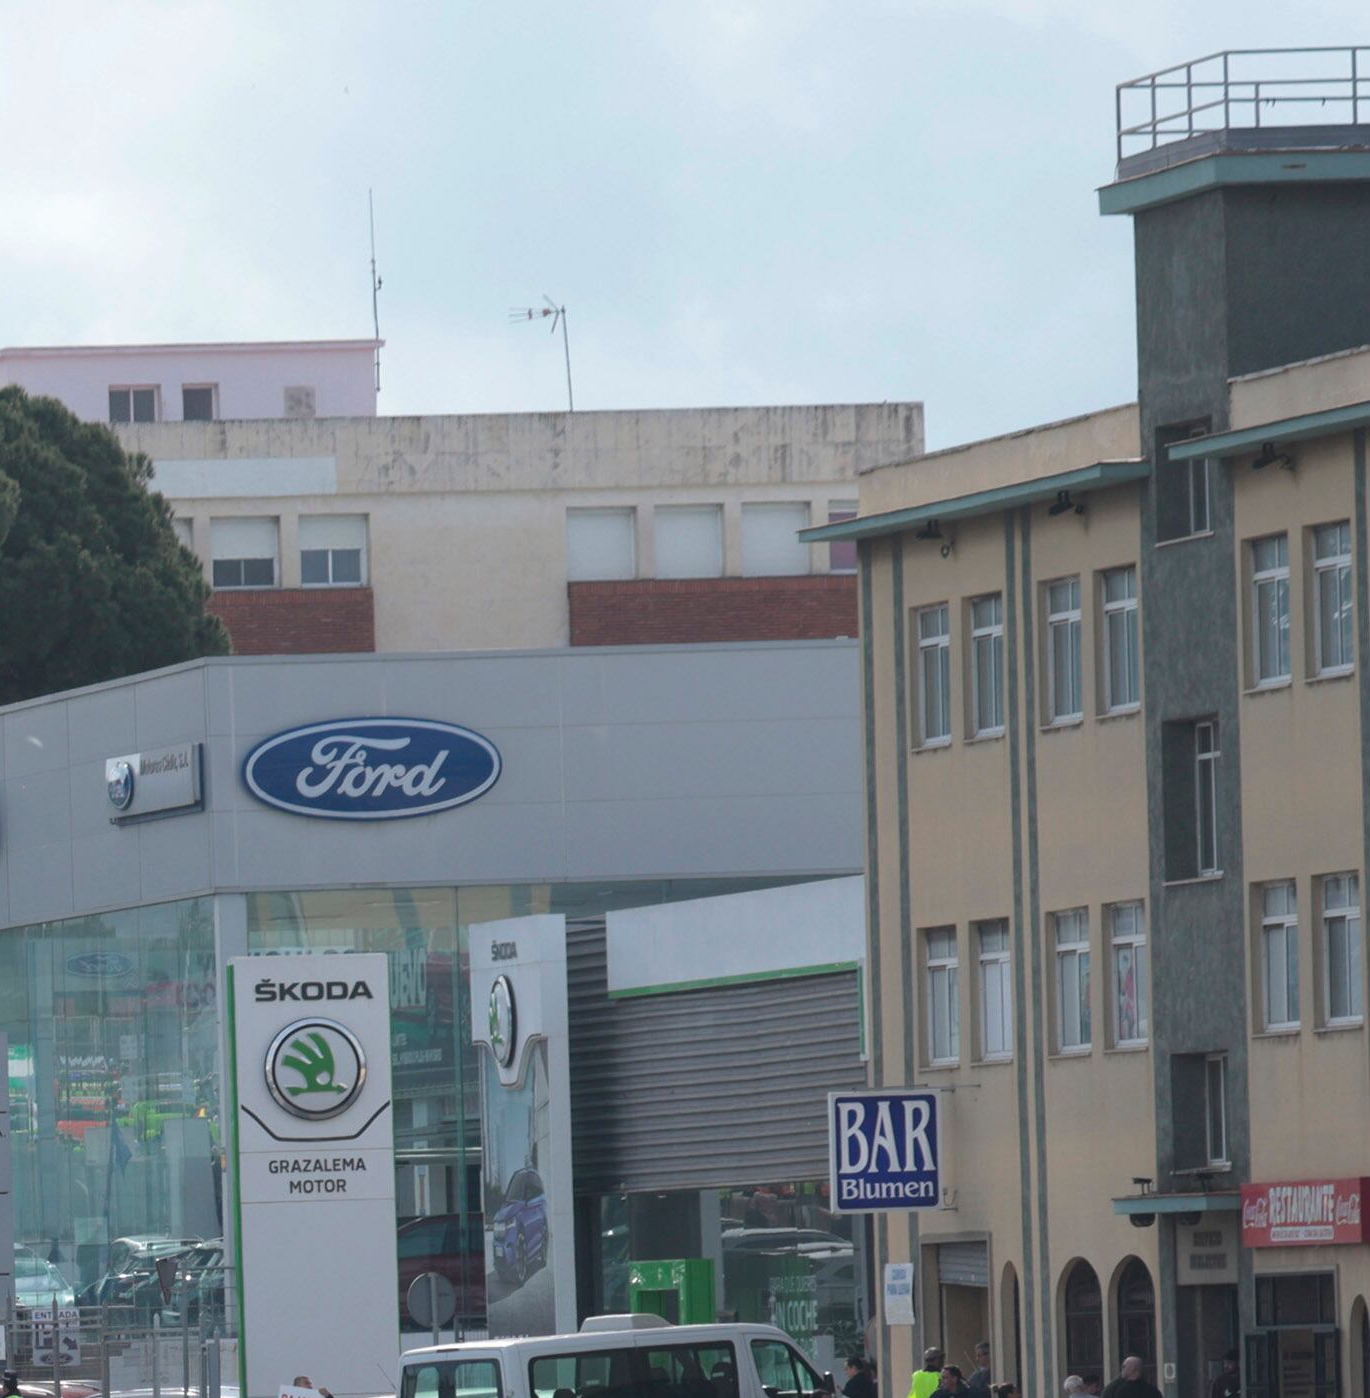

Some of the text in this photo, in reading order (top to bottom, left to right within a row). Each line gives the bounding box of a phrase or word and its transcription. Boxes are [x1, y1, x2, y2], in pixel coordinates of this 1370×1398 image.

[296, 735, 450, 798] Ford
[255, 978, 374, 1003] ŠKODA
[837, 1100, 936, 1174] BAR
[268, 1157, 367, 1174] GRAZALEMA
[289, 1179, 347, 1194] MOTOR
[841, 1178, 934, 1200] Blumen
[1269, 1184, 1334, 1224] RESTAURANTE
[35, 1311, 78, 1321] ENTADA
